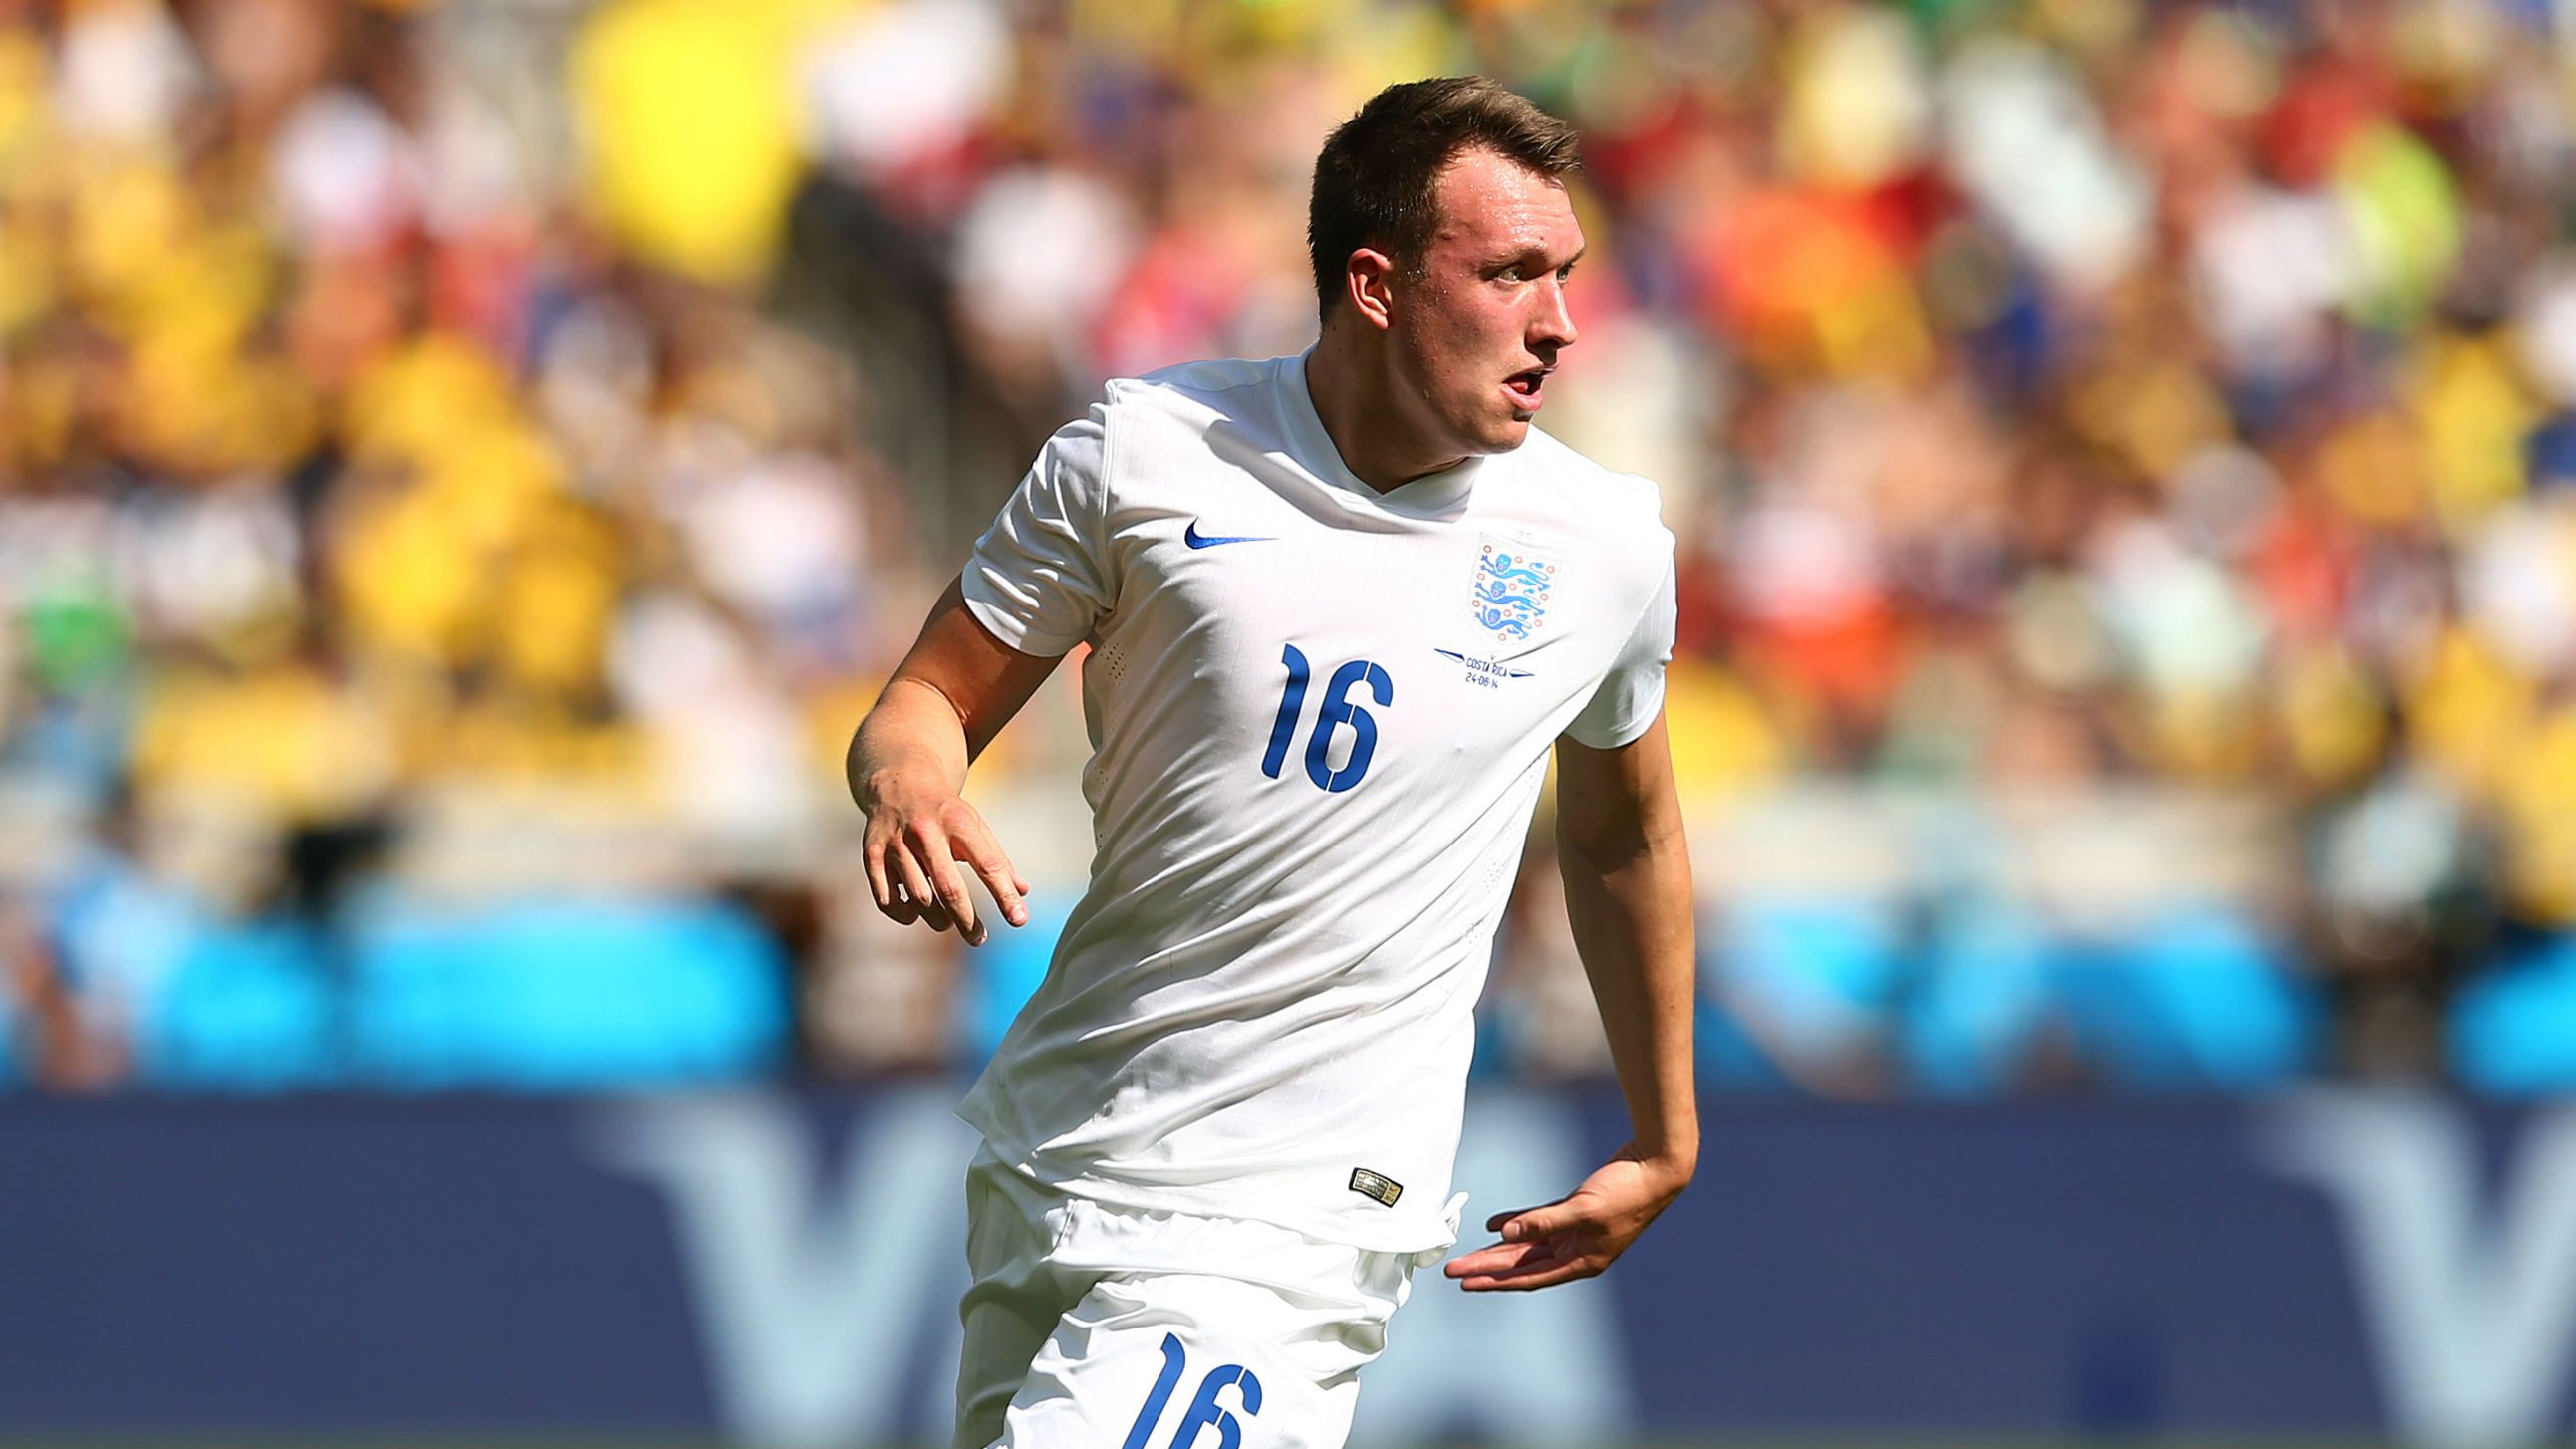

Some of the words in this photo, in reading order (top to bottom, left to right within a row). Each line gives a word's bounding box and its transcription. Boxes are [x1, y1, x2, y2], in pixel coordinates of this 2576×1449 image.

[1261, 643, 1394, 793] 16
[1466, 657, 1490, 672] COSTA
[1491, 663, 1507, 677] RICA
[1122, 1332, 1263, 1449] 16
